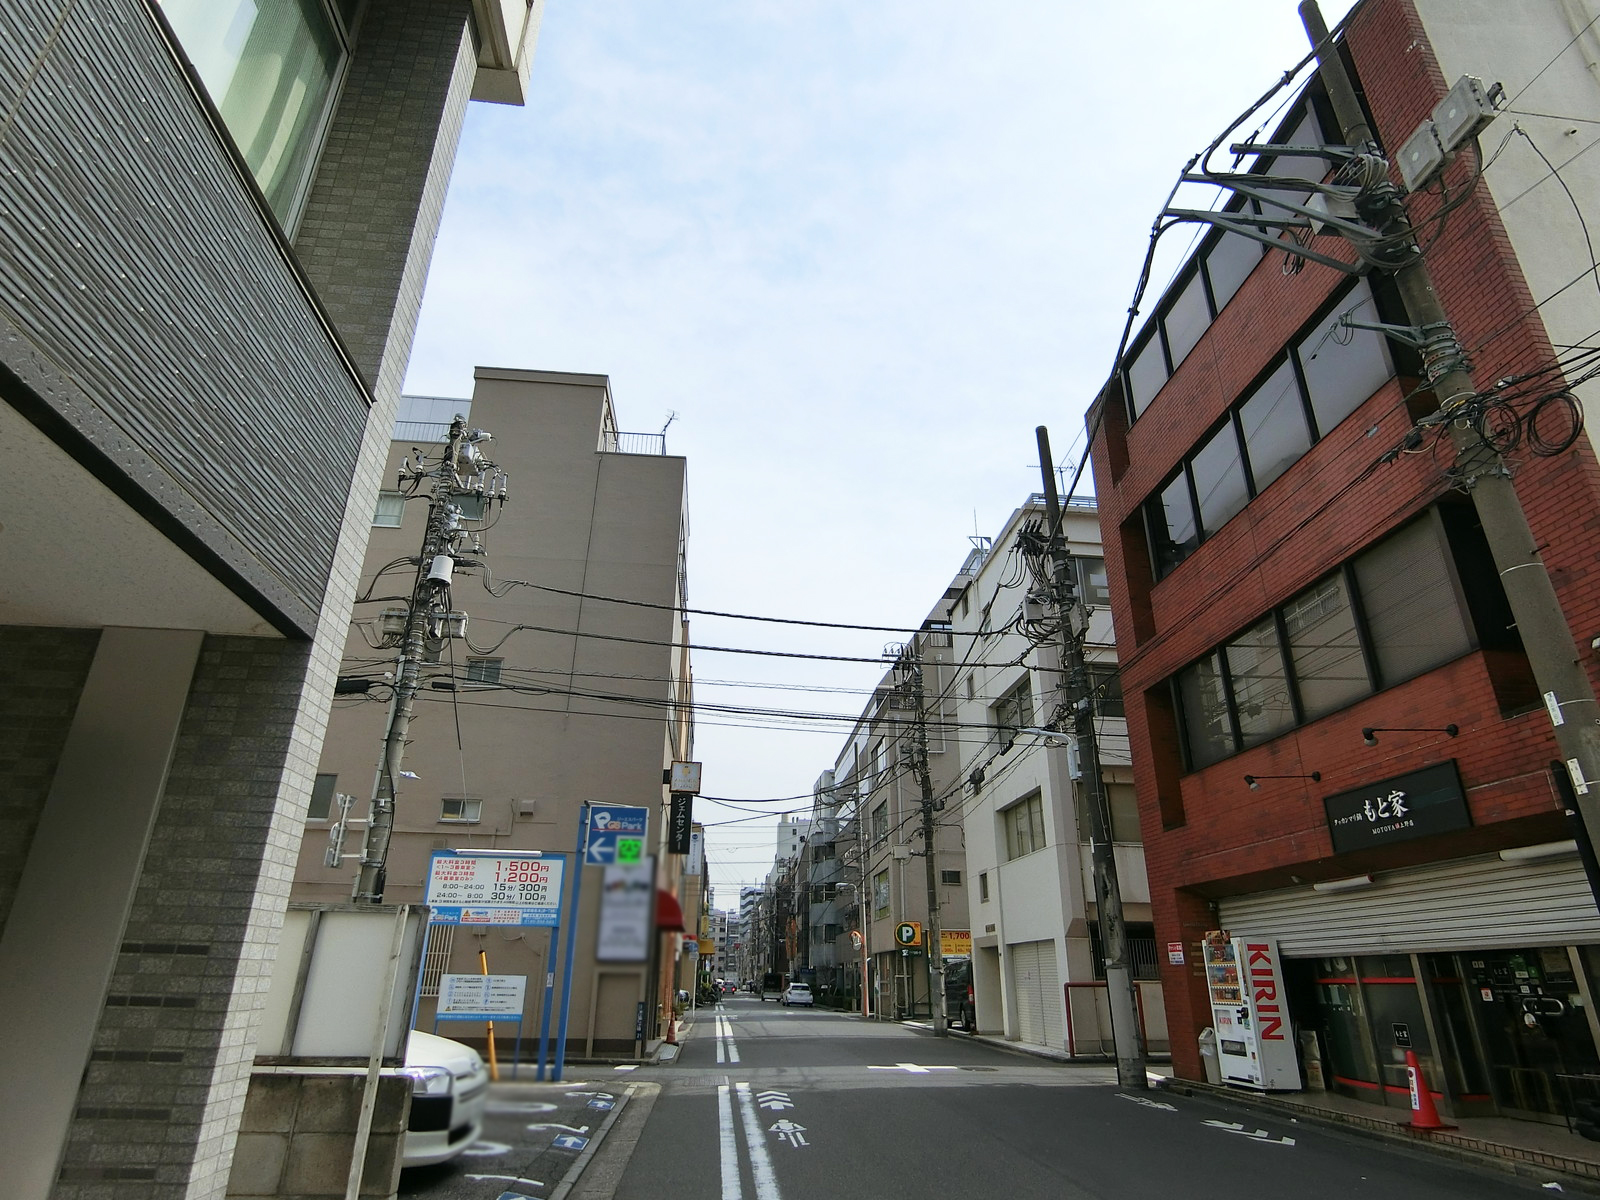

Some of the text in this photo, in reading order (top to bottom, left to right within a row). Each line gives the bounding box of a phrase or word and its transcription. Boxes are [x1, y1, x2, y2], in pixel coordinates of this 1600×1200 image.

[1363, 790, 1409, 822] もと家
[621, 821, 643, 830] Park
[1371, 824, 1396, 835] MOTOYA
[496, 860, 550, 872] 1,500円
[495, 871, 548, 883] 1,200円
[902, 926, 913, 942] P
[1247, 944, 1285, 1041] KIRIN
